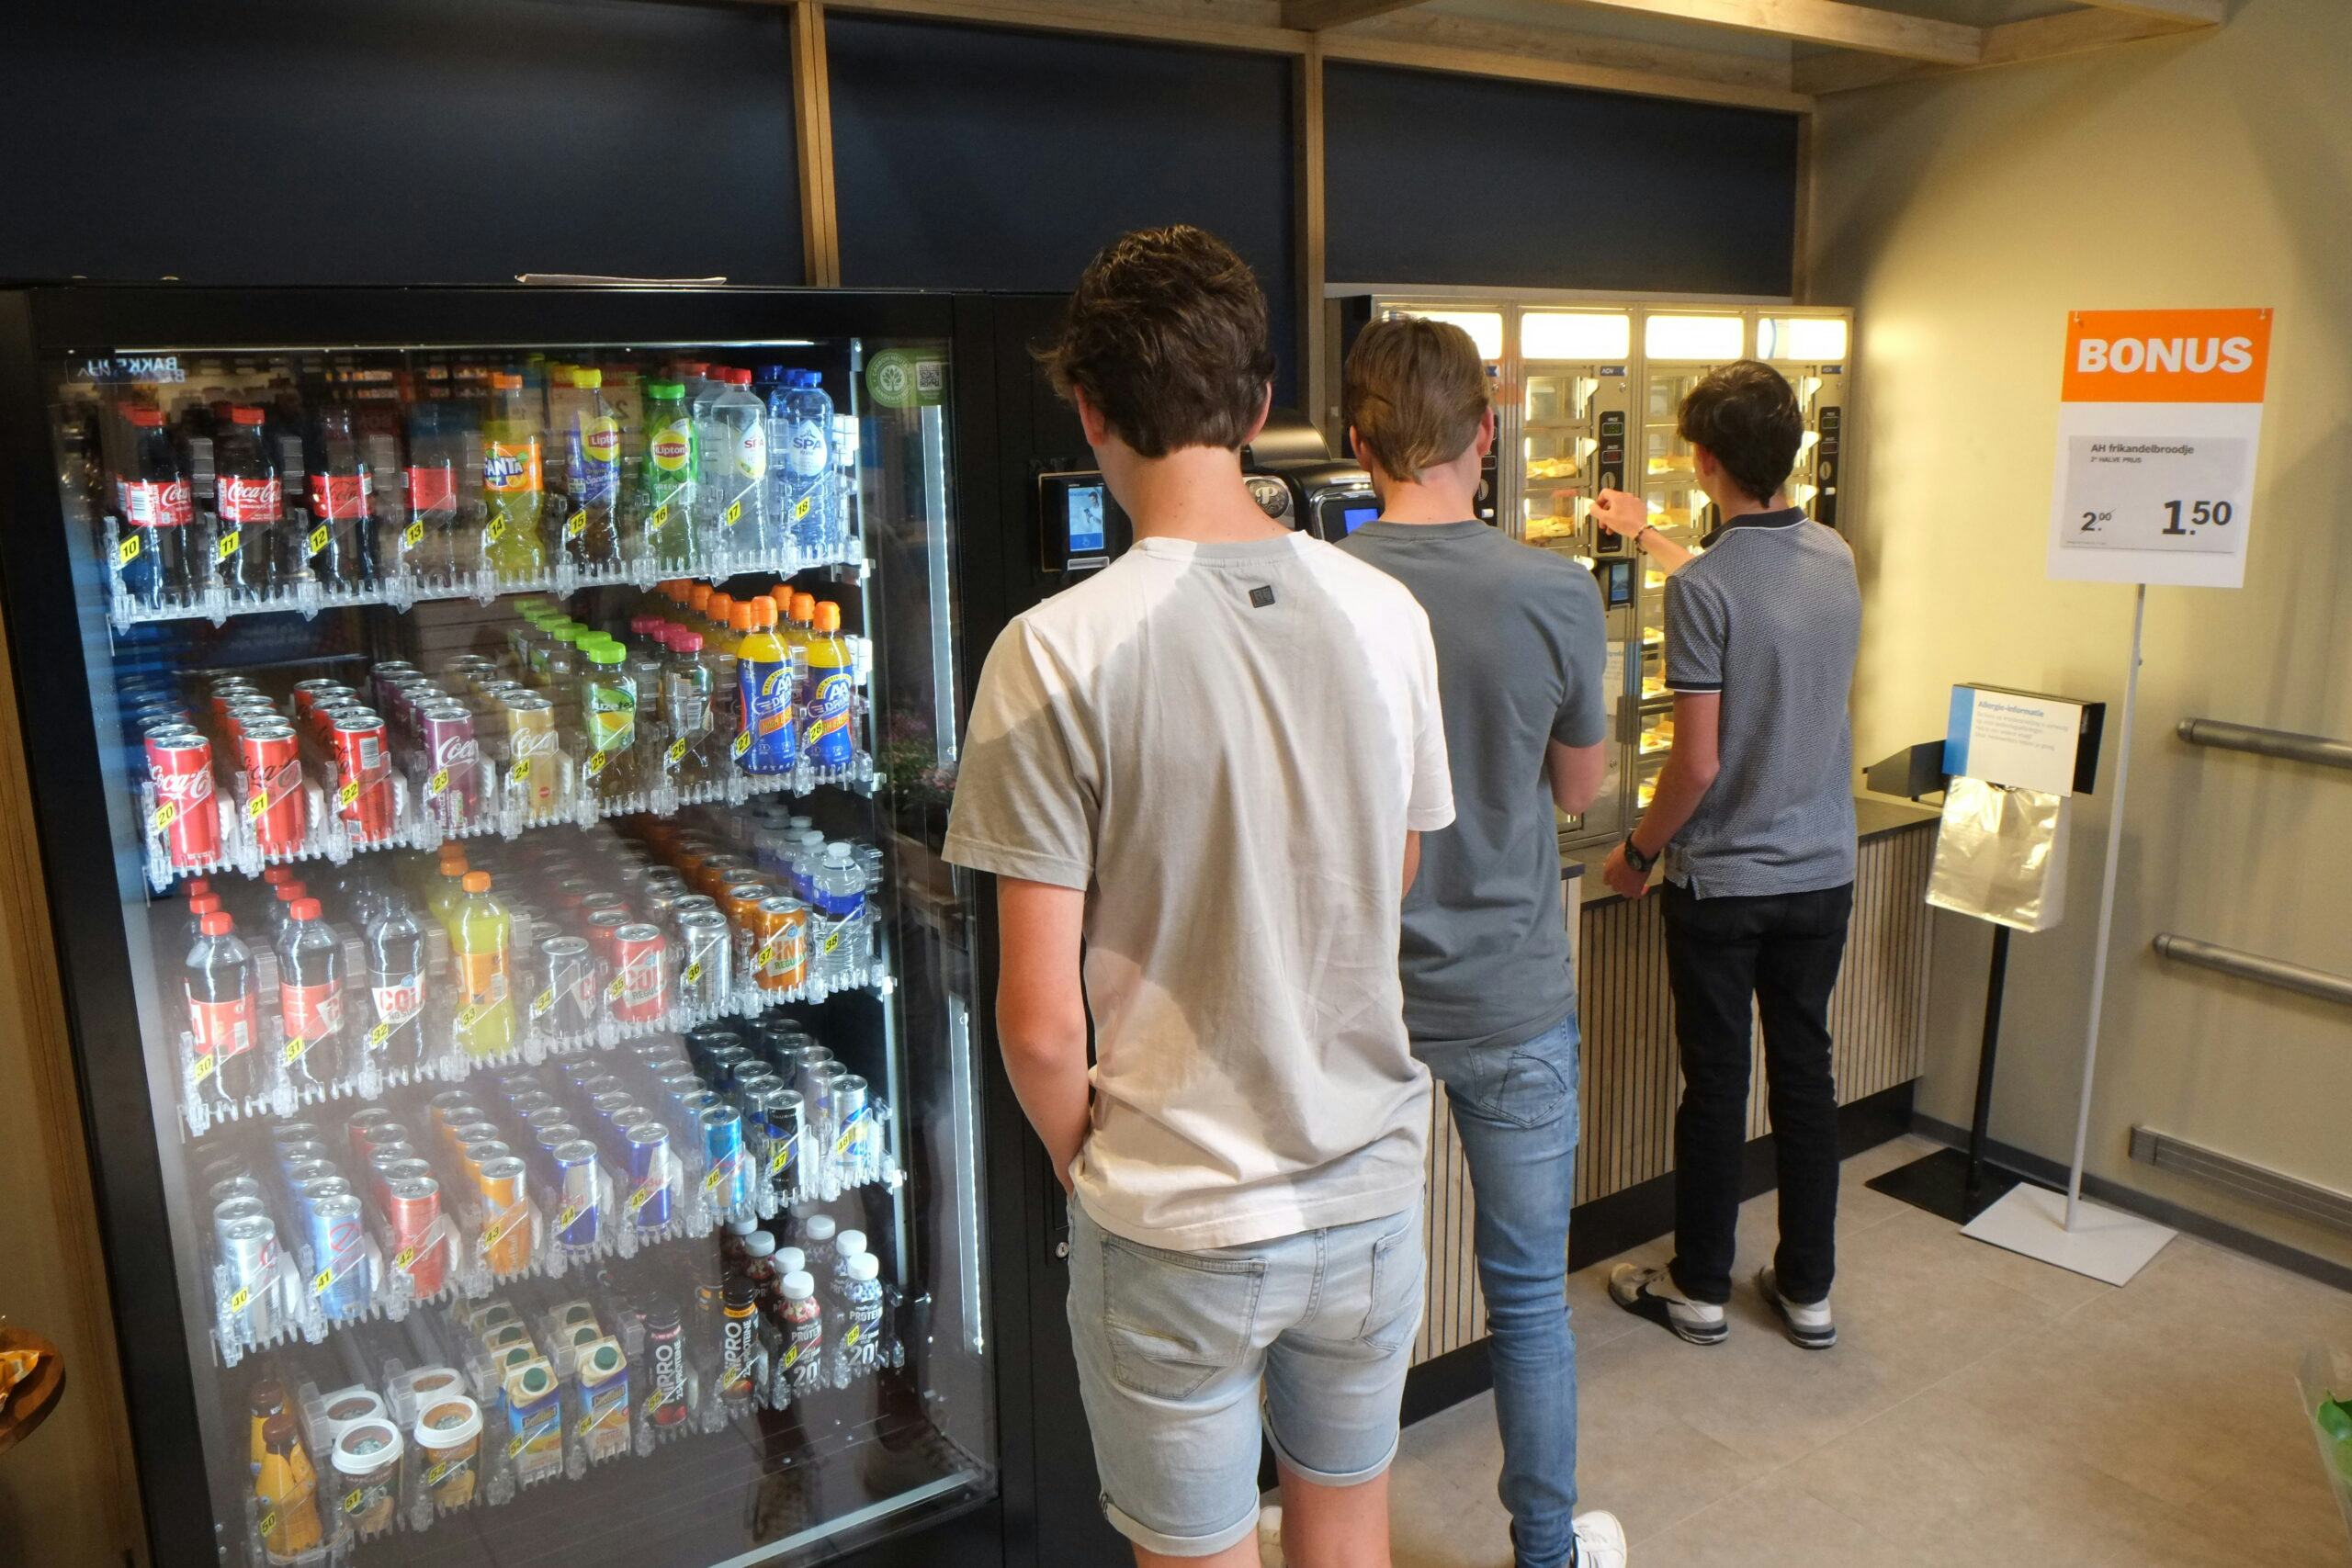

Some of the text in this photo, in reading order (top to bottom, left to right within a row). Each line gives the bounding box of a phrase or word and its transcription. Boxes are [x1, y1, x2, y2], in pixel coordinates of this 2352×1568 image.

[2077, 337, 2253, 373] BONUS
[654, 444, 685, 457] Lipton
[793, 437, 821, 451] SPA
[2090, 444, 2195, 456] AH frikandelbroodje
[483, 457, 523, 476] ANTA
[655, 509, 666, 524] 16
[729, 504, 739, 520] 17
[797, 501, 808, 515] 18
[573, 514, 584, 530] 15
[2162, 500, 2233, 536] 1.50
[410, 525, 420, 540] 13
[492, 519, 502, 535] 14
[222, 537, 233, 552] 11
[313, 530, 324, 547] 12
[123, 540, 137, 558] 10
[829, 681, 849, 702] AA
[809, 723, 821, 739] 28
[673, 740, 684, 758] 26
[738, 734, 749, 751] 27
[591, 751, 603, 770] 25
[515, 761, 528, 779] 24
[434, 772, 447, 790] 23
[341, 784, 356, 802] 22
[252, 797, 264, 815] 21
[158, 807, 173, 826] 20
[825, 935, 837, 951] 38
[760, 947, 772, 964] 37
[774, 953, 807, 970] REGU
[689, 963, 700, 980] 36
[613, 977, 624, 995] 35
[630, 979, 667, 1000] REGUL
[379, 981, 425, 1015] COL
[462, 1008, 476, 1025] 33
[373, 1024, 388, 1041] 32
[288, 1041, 300, 1057] 31
[198, 1058, 211, 1076] 30
[838, 1136, 848, 1151] 48
[774, 1153, 786, 1168] 47
[562, 1208, 574, 1224] 44
[487, 1226, 499, 1242] 43
[400, 1248, 412, 1264] 42
[318, 1271, 329, 1288] 41
[233, 1290, 247, 1306] 40
[848, 1328, 859, 1343] 58
[786, 1349, 796, 1364] 57
[345, 1493, 357, 1508] 51
[262, 1515, 275, 1533] 50
